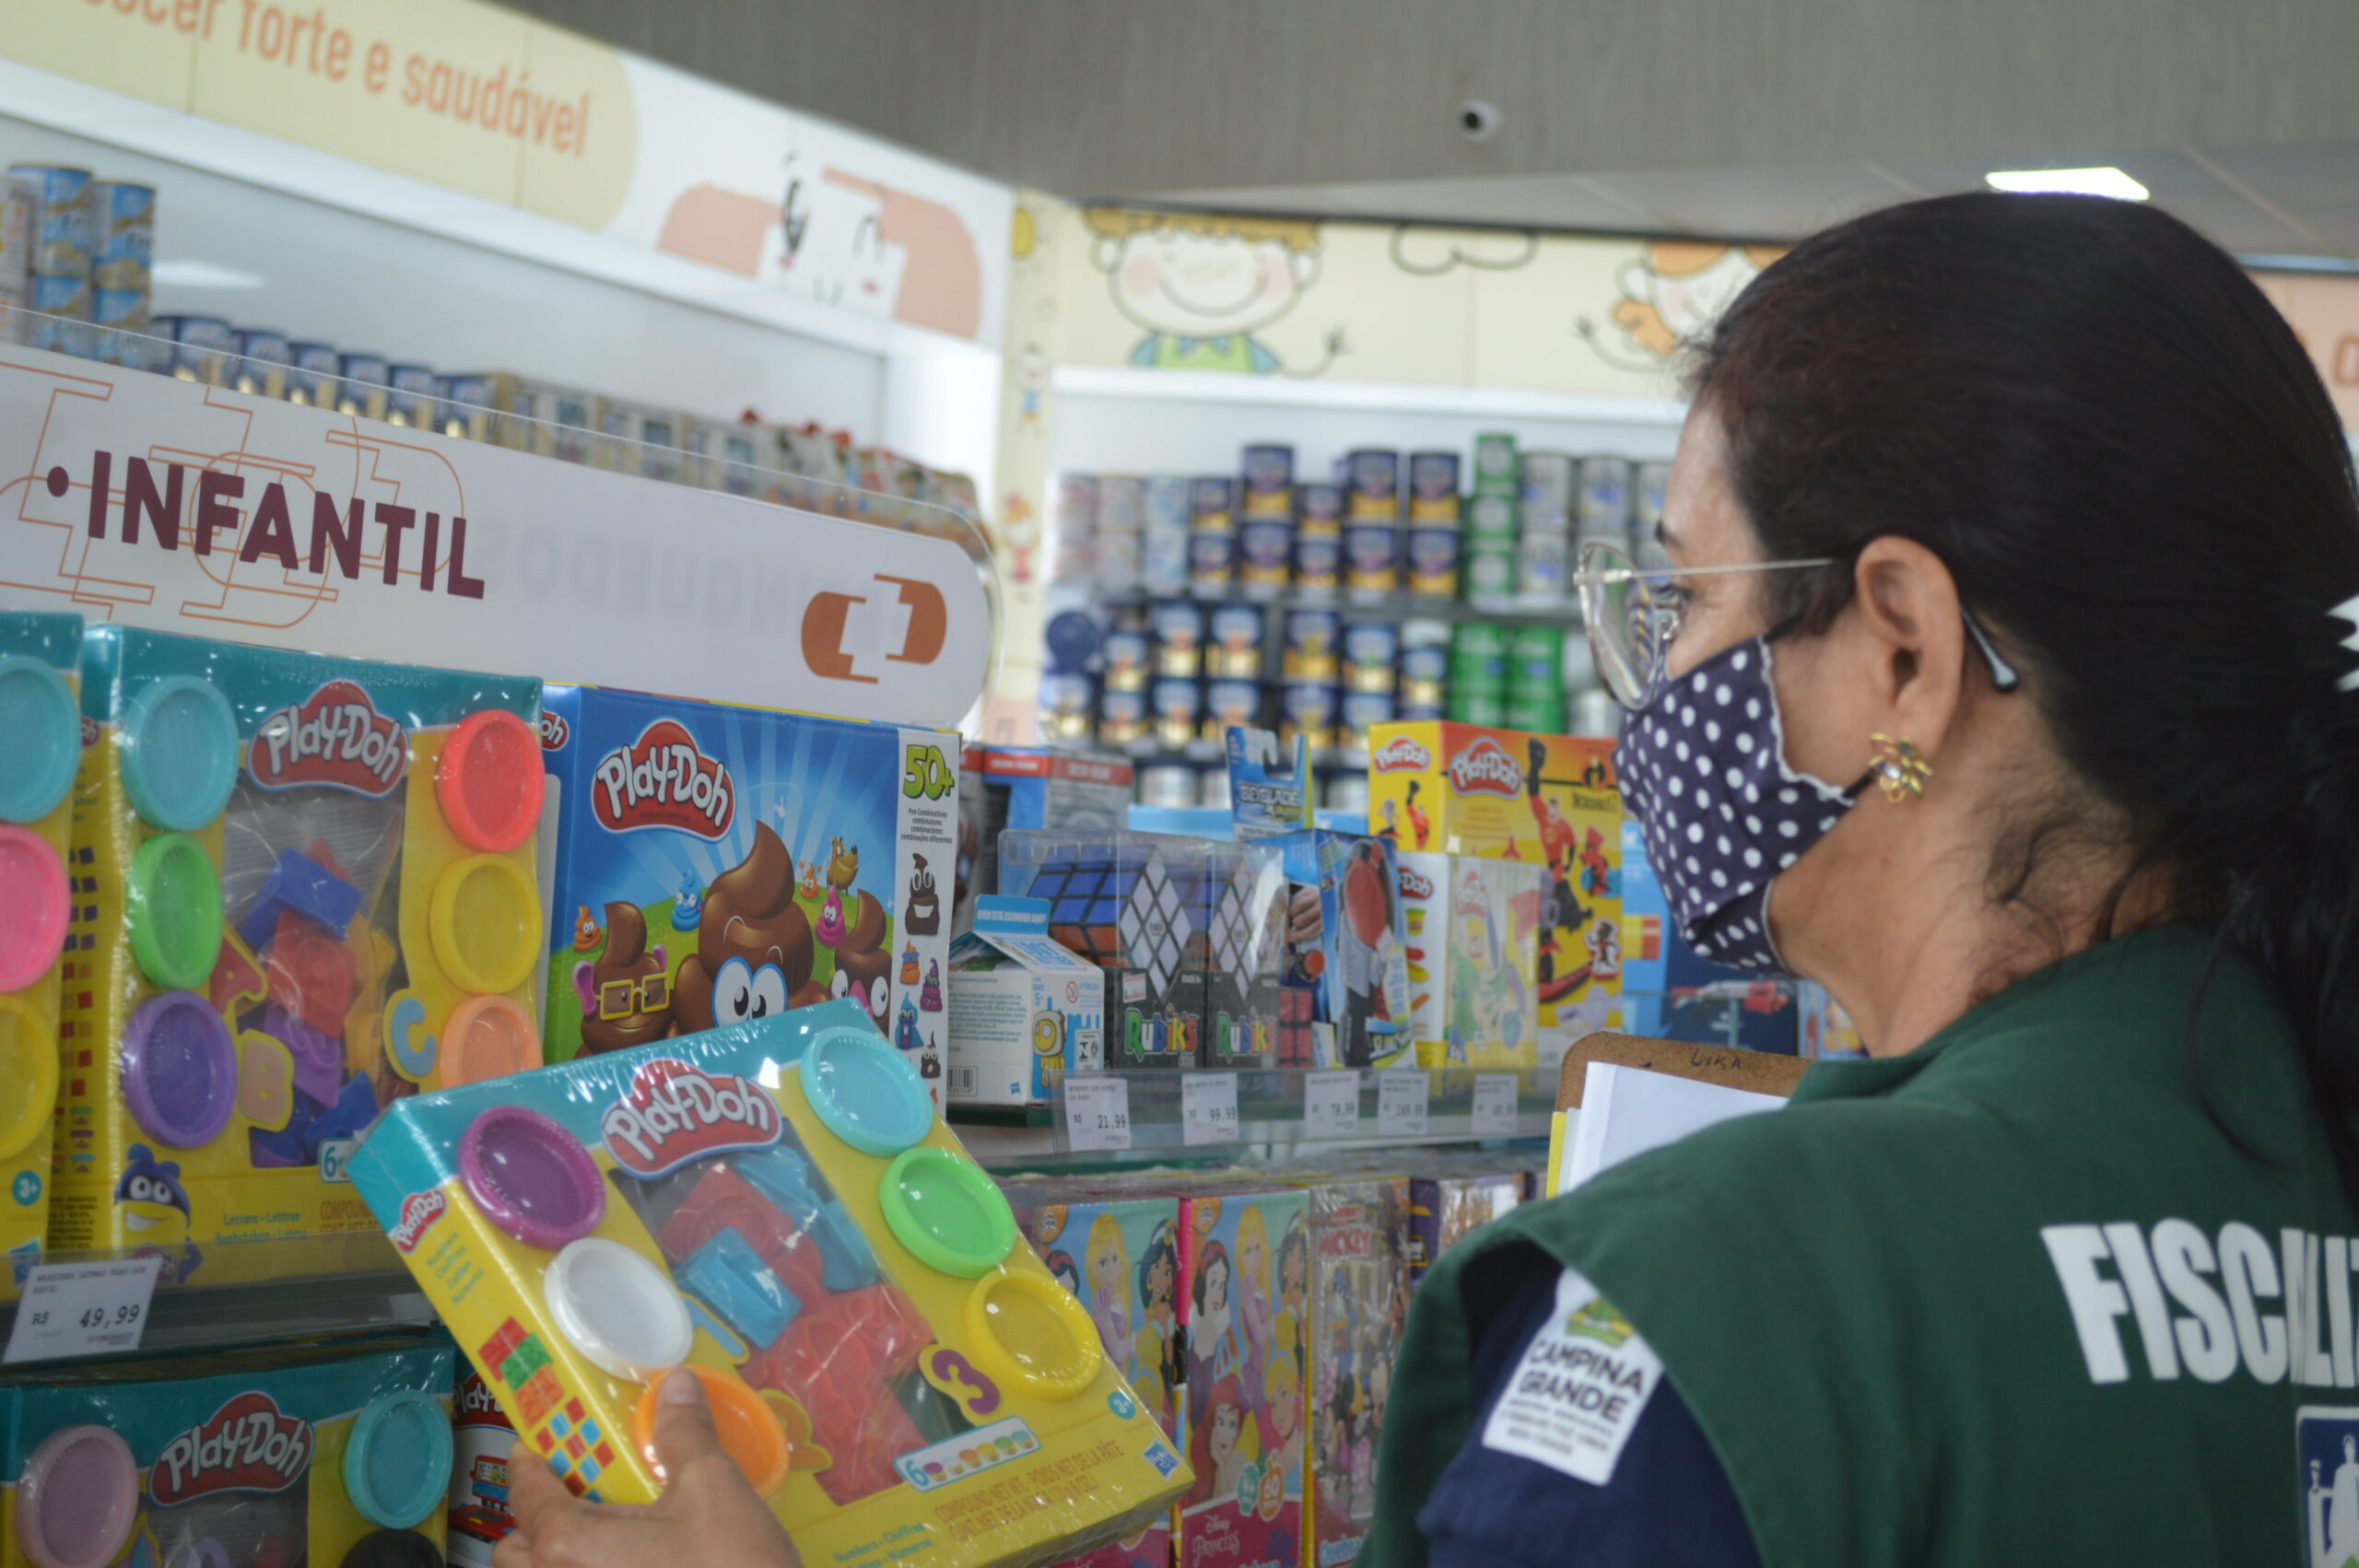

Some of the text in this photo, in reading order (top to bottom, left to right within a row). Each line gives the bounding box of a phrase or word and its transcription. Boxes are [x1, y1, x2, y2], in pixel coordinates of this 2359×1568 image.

[236, 0, 354, 83] forte
[363, 41, 391, 95] e
[402, 53, 593, 158] saudável
[88, 451, 486, 600] INFANTIL
[258, 703, 401, 784] Play-Doh
[1451, 748, 1522, 790] Play-Doh
[596, 743, 730, 828] Play-Doh
[903, 744, 955, 801] 50+
[604, 1073, 770, 1162] Play-Doh
[1097, 1114, 1126, 1130] 21,99
[223, 1212, 259, 1226] Letters
[31, 1305, 140, 1329] R$ 49,99
[1530, 1339, 1644, 1397] CAMPINA
[1519, 1370, 1629, 1424] GRANDE
[160, 1410, 307, 1493] Play-Doh
[905, 1459, 930, 1487] 6
